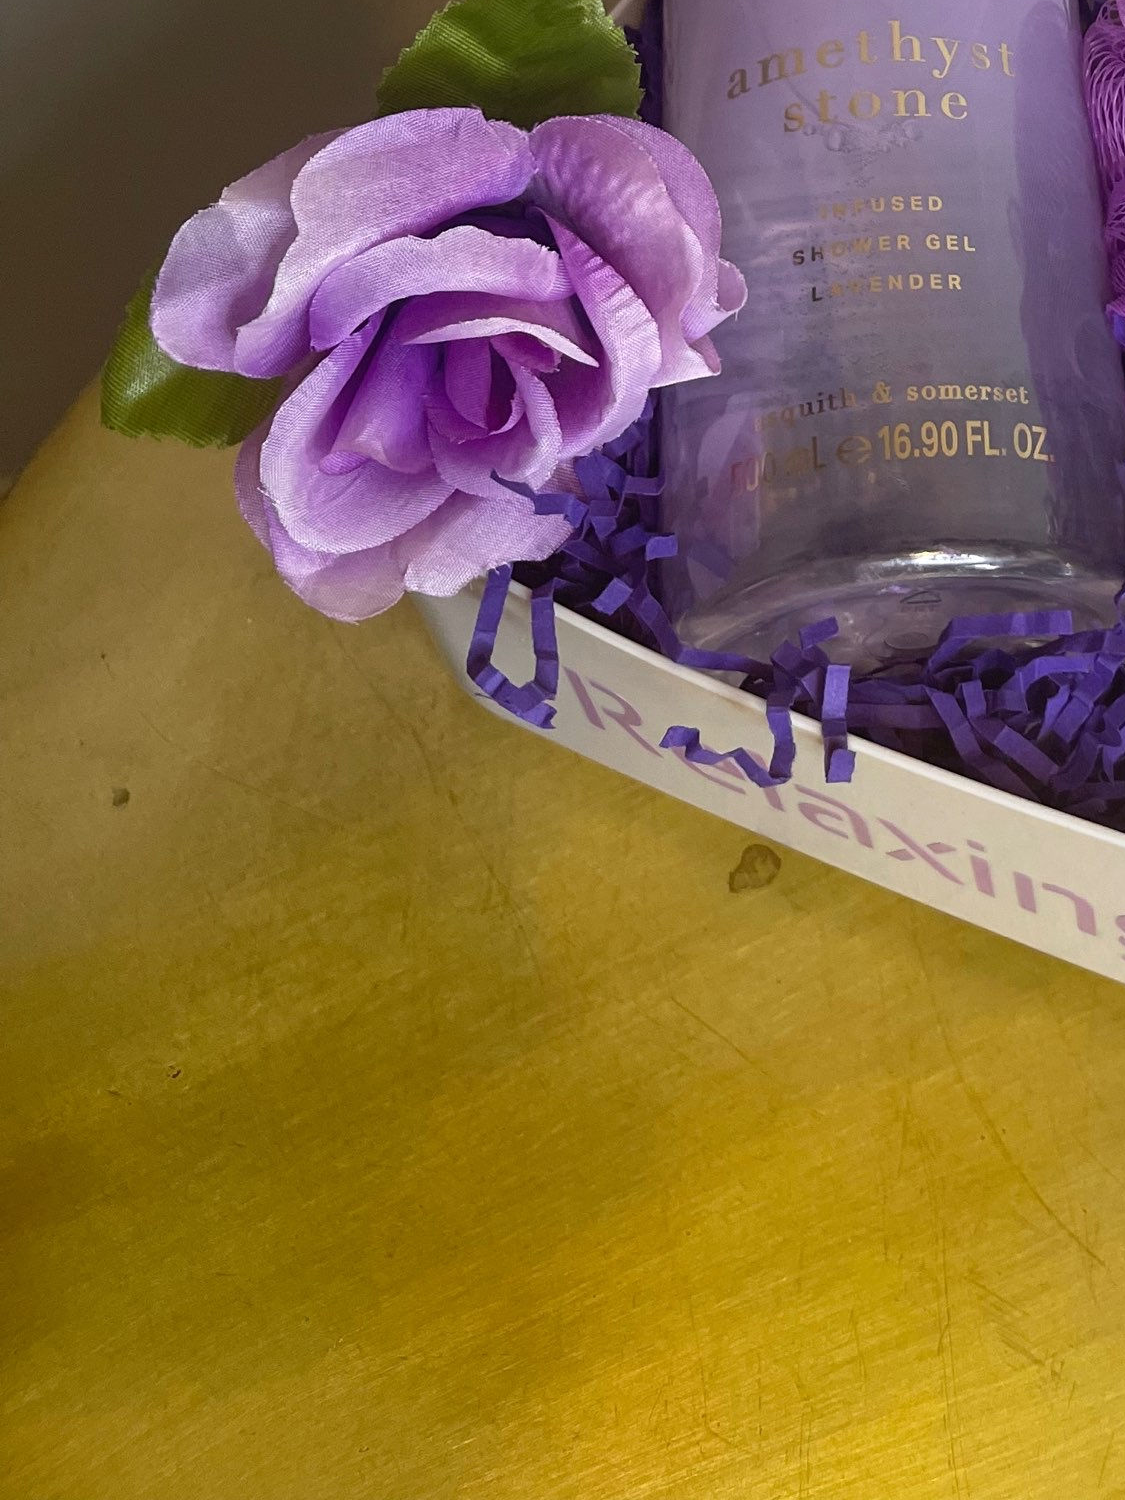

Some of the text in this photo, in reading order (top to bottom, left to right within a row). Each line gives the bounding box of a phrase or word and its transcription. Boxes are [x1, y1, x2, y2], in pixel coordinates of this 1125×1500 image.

[726, 20, 1016, 99] amethyst
[783, 88, 968, 132] stone
[792, 234, 976, 266] SHOWER GEL
[754, 380, 1030, 432] quith & somerset
[877, 421, 958, 460] 16.90
[965, 420, 1007, 456] FL.
[1013, 422, 1056, 462] OZ.
